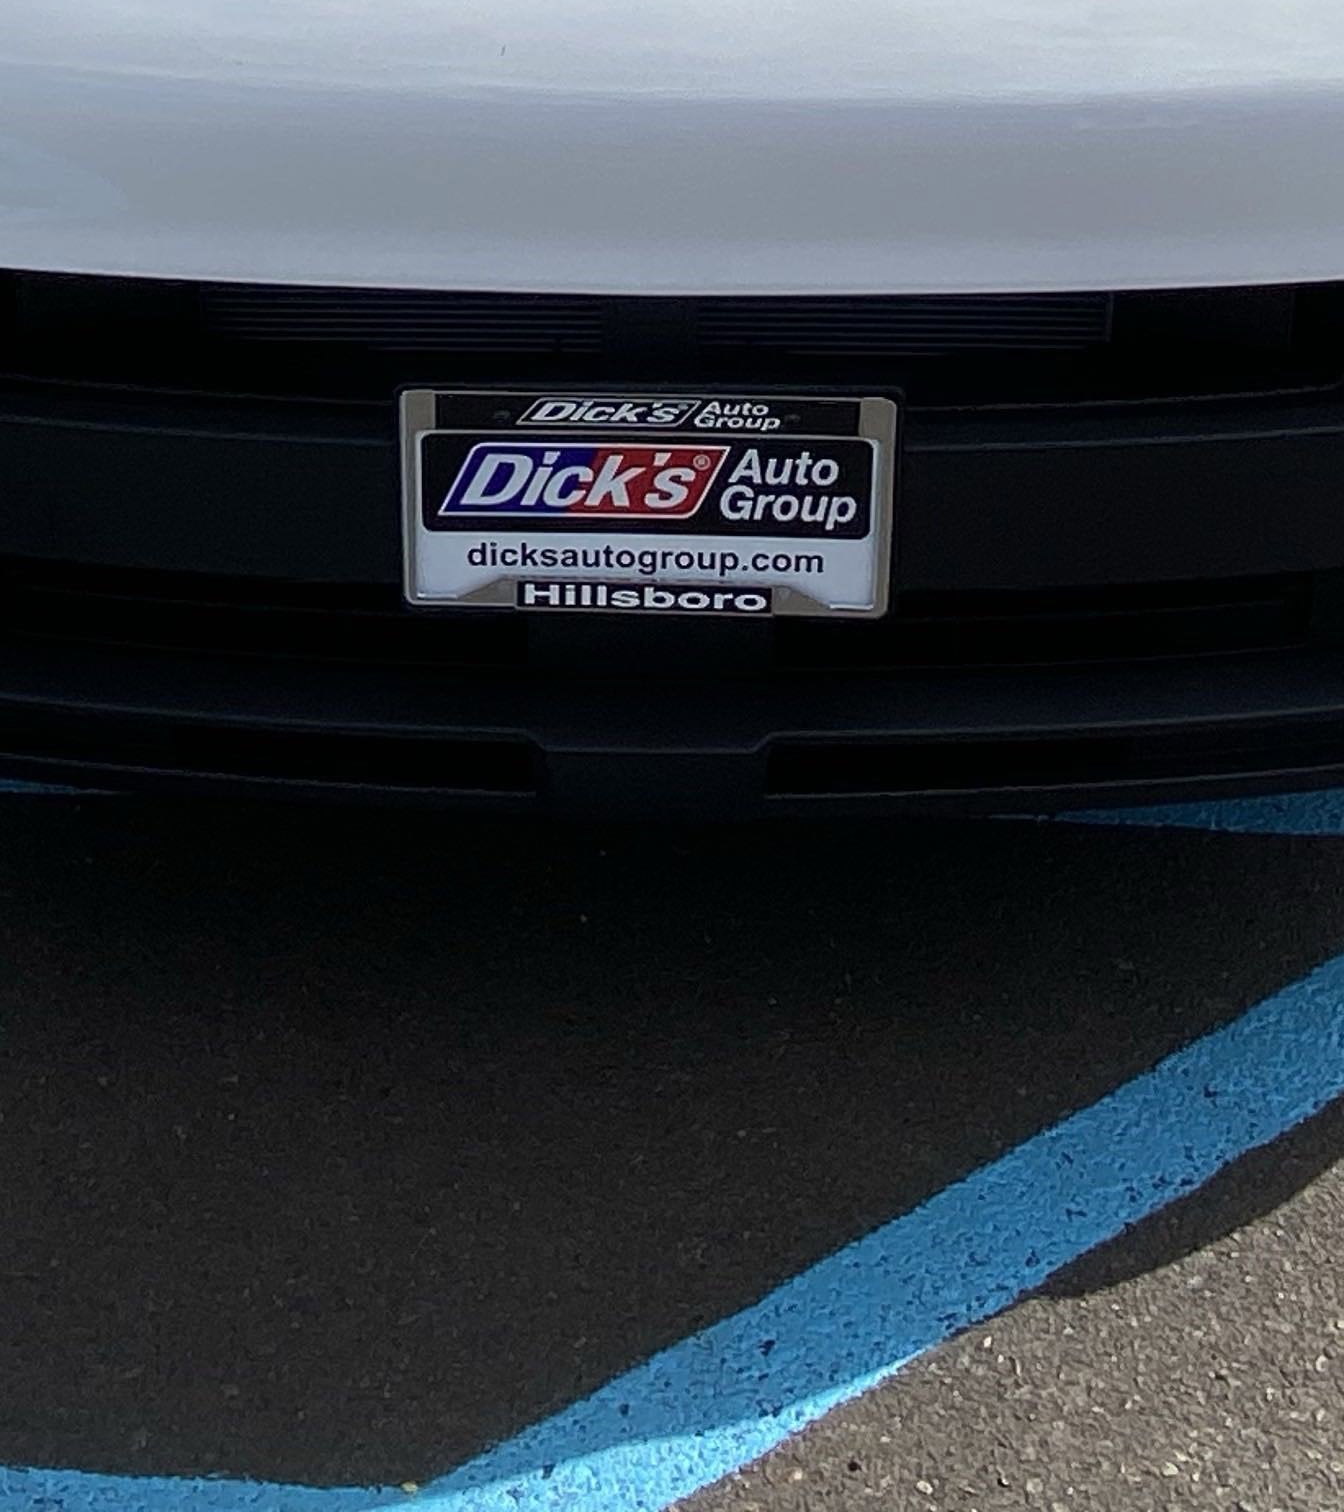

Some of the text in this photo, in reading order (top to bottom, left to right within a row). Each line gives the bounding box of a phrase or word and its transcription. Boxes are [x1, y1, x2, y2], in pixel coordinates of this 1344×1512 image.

[531, 401, 679, 423] Dick's
[693, 414, 781, 431] Group
[702, 401, 769, 417] Auto
[459, 451, 698, 509] Dick's
[728, 449, 840, 486] Auto
[719, 487, 857, 530] Group
[467, 542, 825, 575] dicksautogroup.com
[523, 583, 768, 610] Hillsboro
